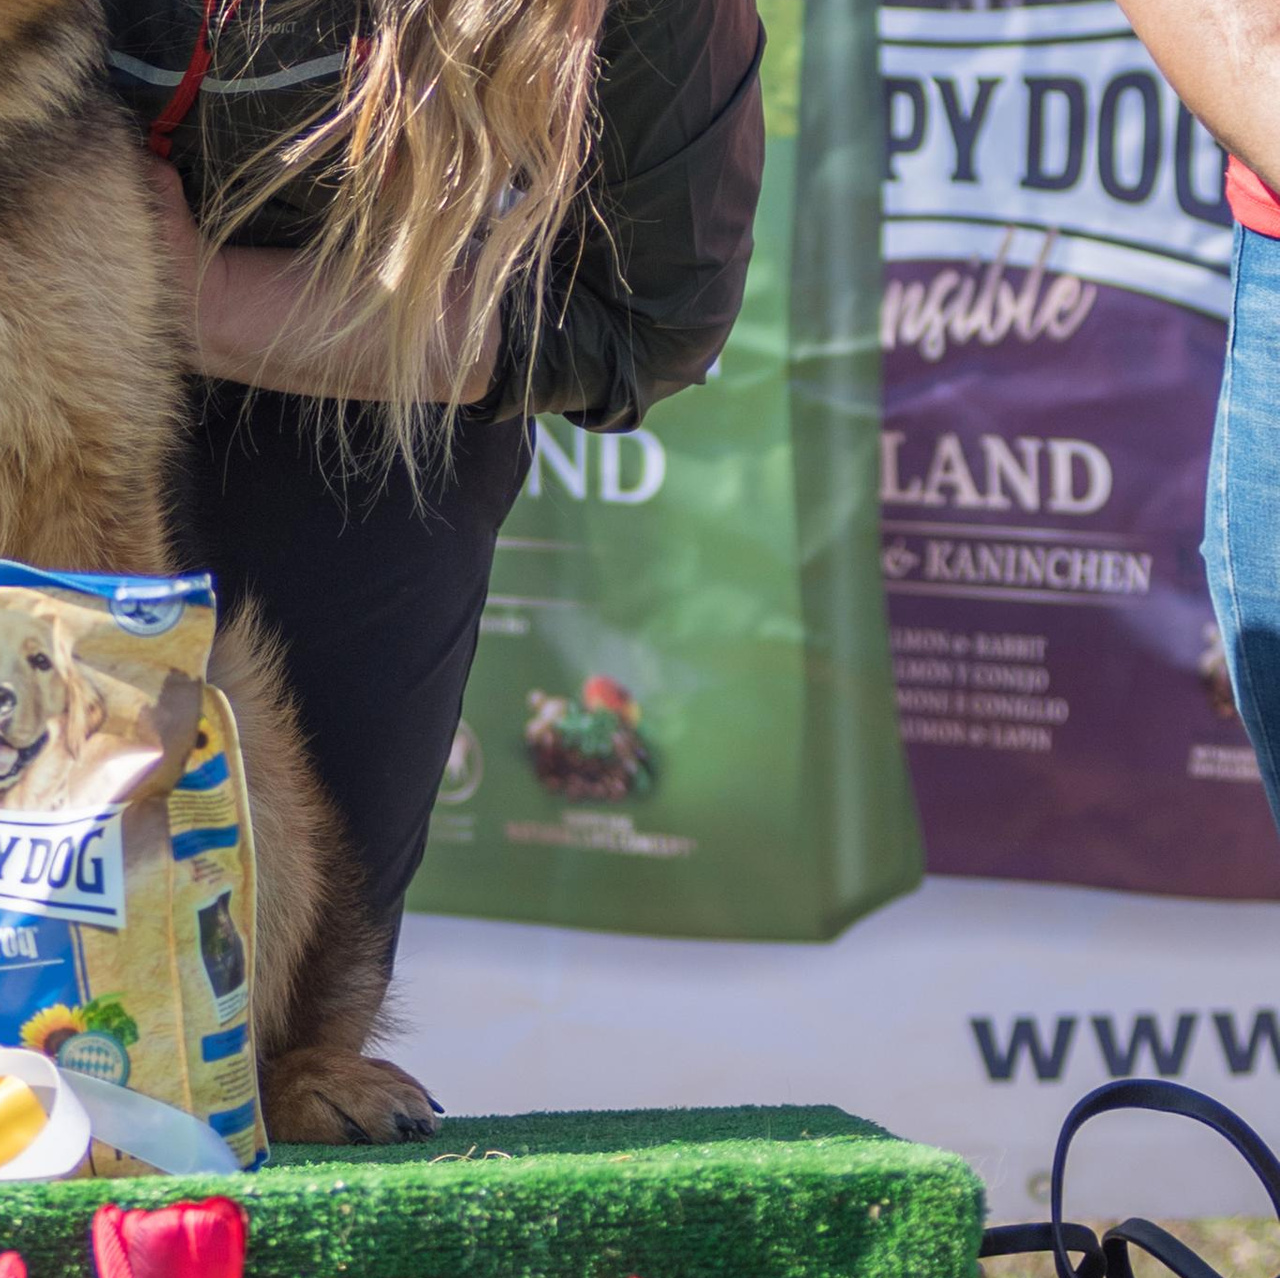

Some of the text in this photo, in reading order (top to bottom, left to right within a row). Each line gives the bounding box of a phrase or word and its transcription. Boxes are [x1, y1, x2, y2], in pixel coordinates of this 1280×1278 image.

[880, 432, 1115, 515] LAND
[924, 539, 1153, 595] KANINCHEN
[20, 826, 106, 895] DOG
